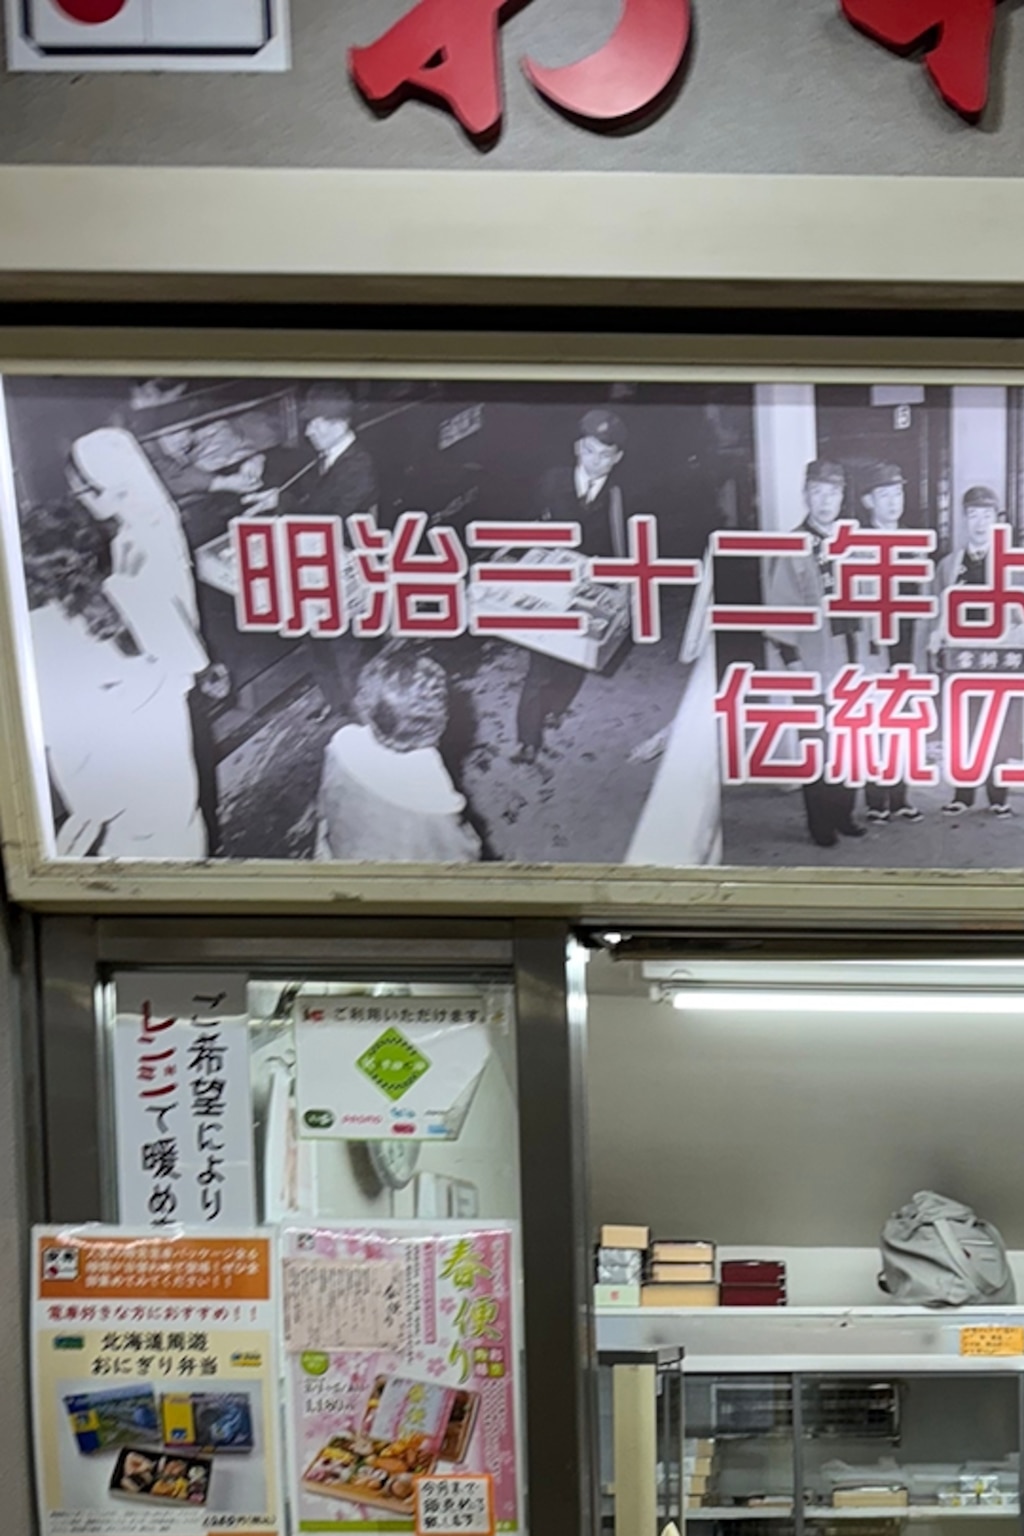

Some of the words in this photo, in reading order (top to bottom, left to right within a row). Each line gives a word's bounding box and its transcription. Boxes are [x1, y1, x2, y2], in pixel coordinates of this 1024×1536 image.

[333, 1005, 487, 1024] ご利用いただけます。
[187, 991, 228, 1222] ご希望により
[101, 1332, 210, 1353] 北海道周遊
[91, 1356, 218, 1377] おにぎり弁当
